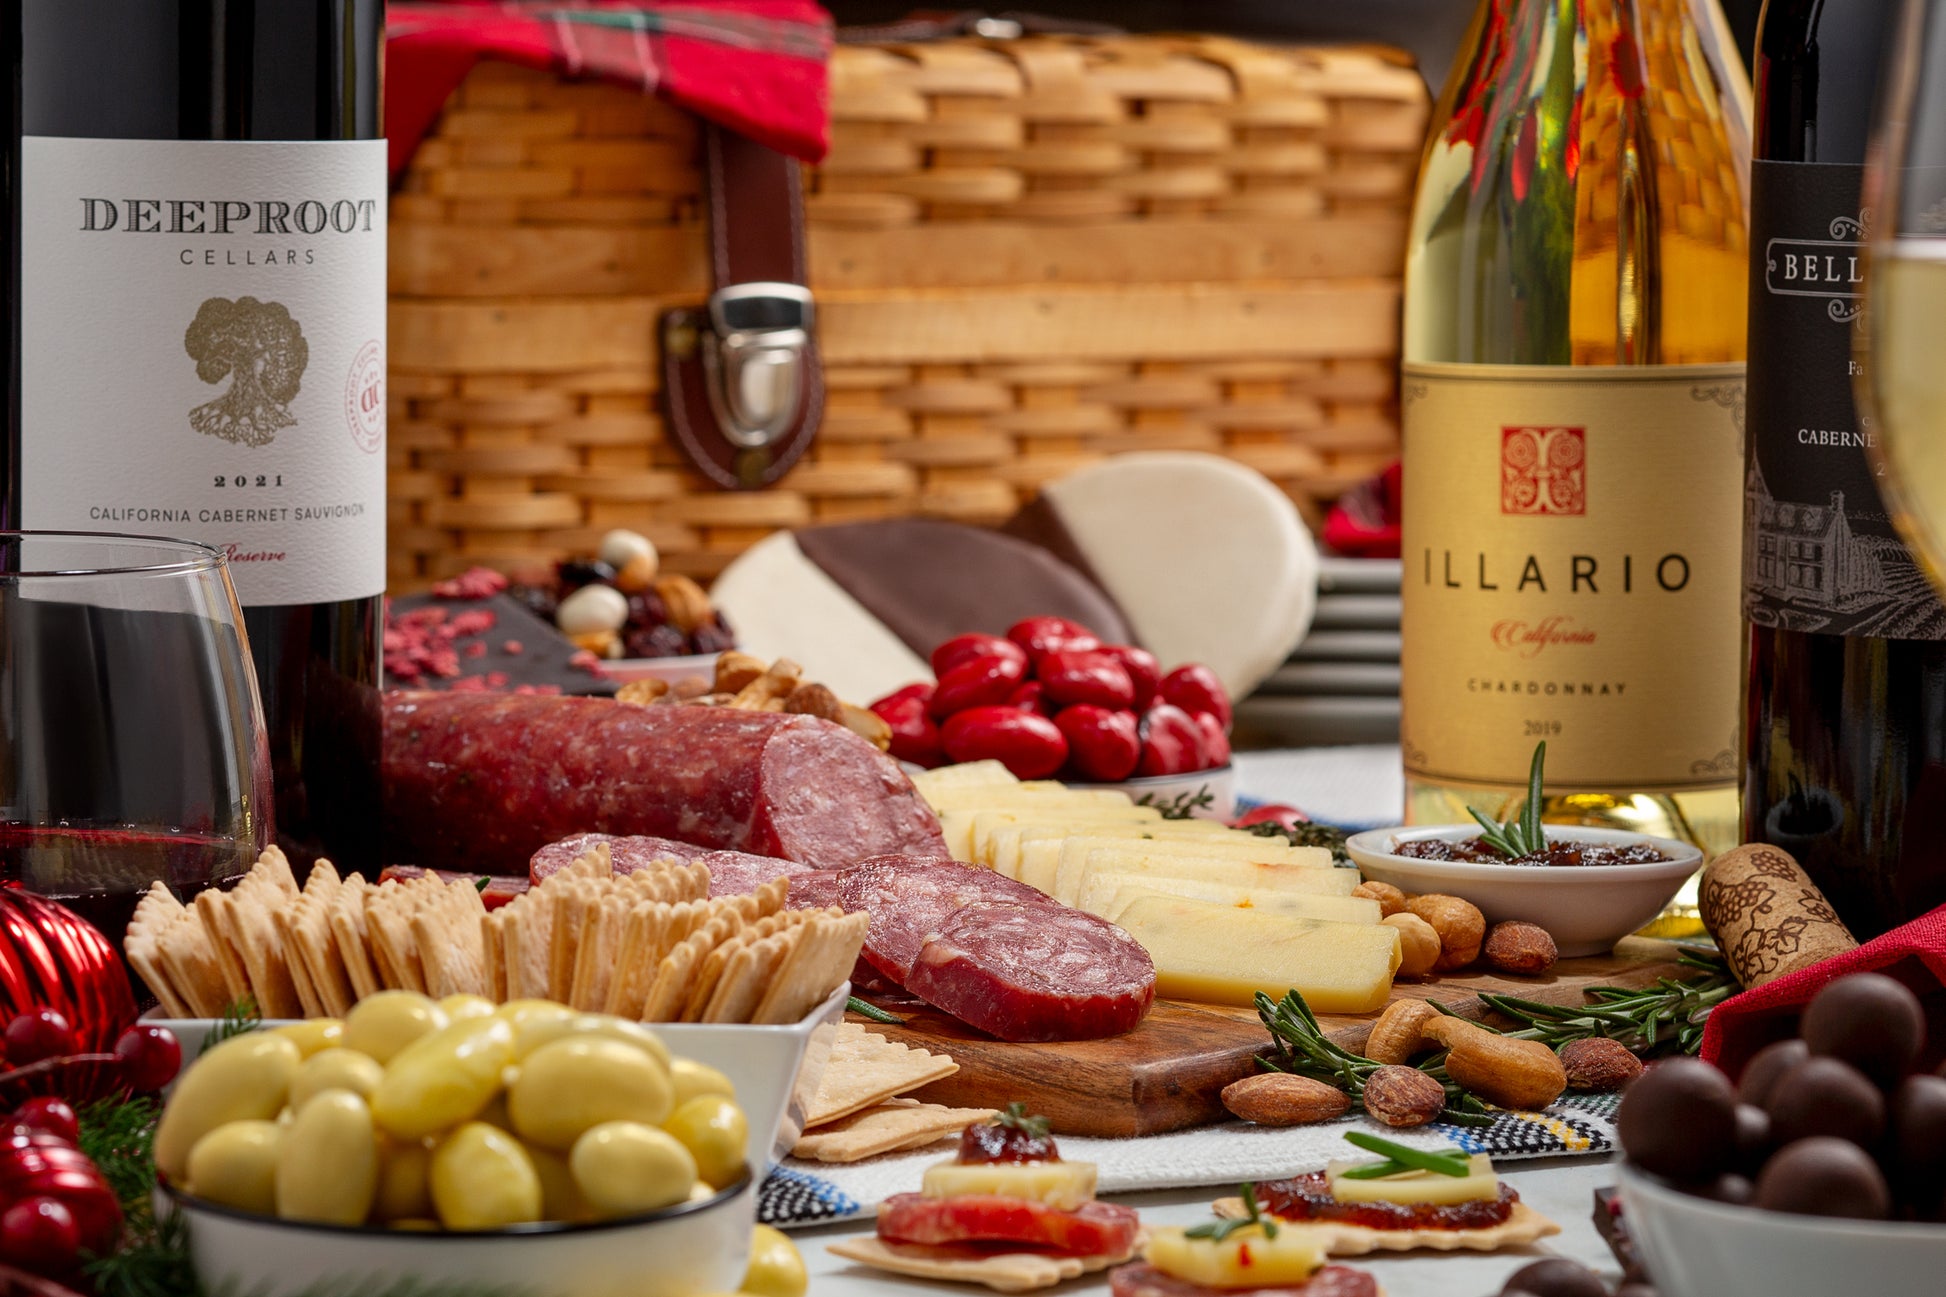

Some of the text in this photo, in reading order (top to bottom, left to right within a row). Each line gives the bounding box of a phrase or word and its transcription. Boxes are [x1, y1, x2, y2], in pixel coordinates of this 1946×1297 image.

[78, 197, 378, 234] DEEPROOT
[180, 249, 316, 265] CELLARS
[213, 475, 284, 488] 2021
[89, 503, 366, 523] CALIFORNIA CABERNET SAUVIGNON
[220, 542, 287, 562] Reserve
[1424, 548, 1691, 593] ILLARIO
[1467, 678, 1626, 696] CHARDONNAY
